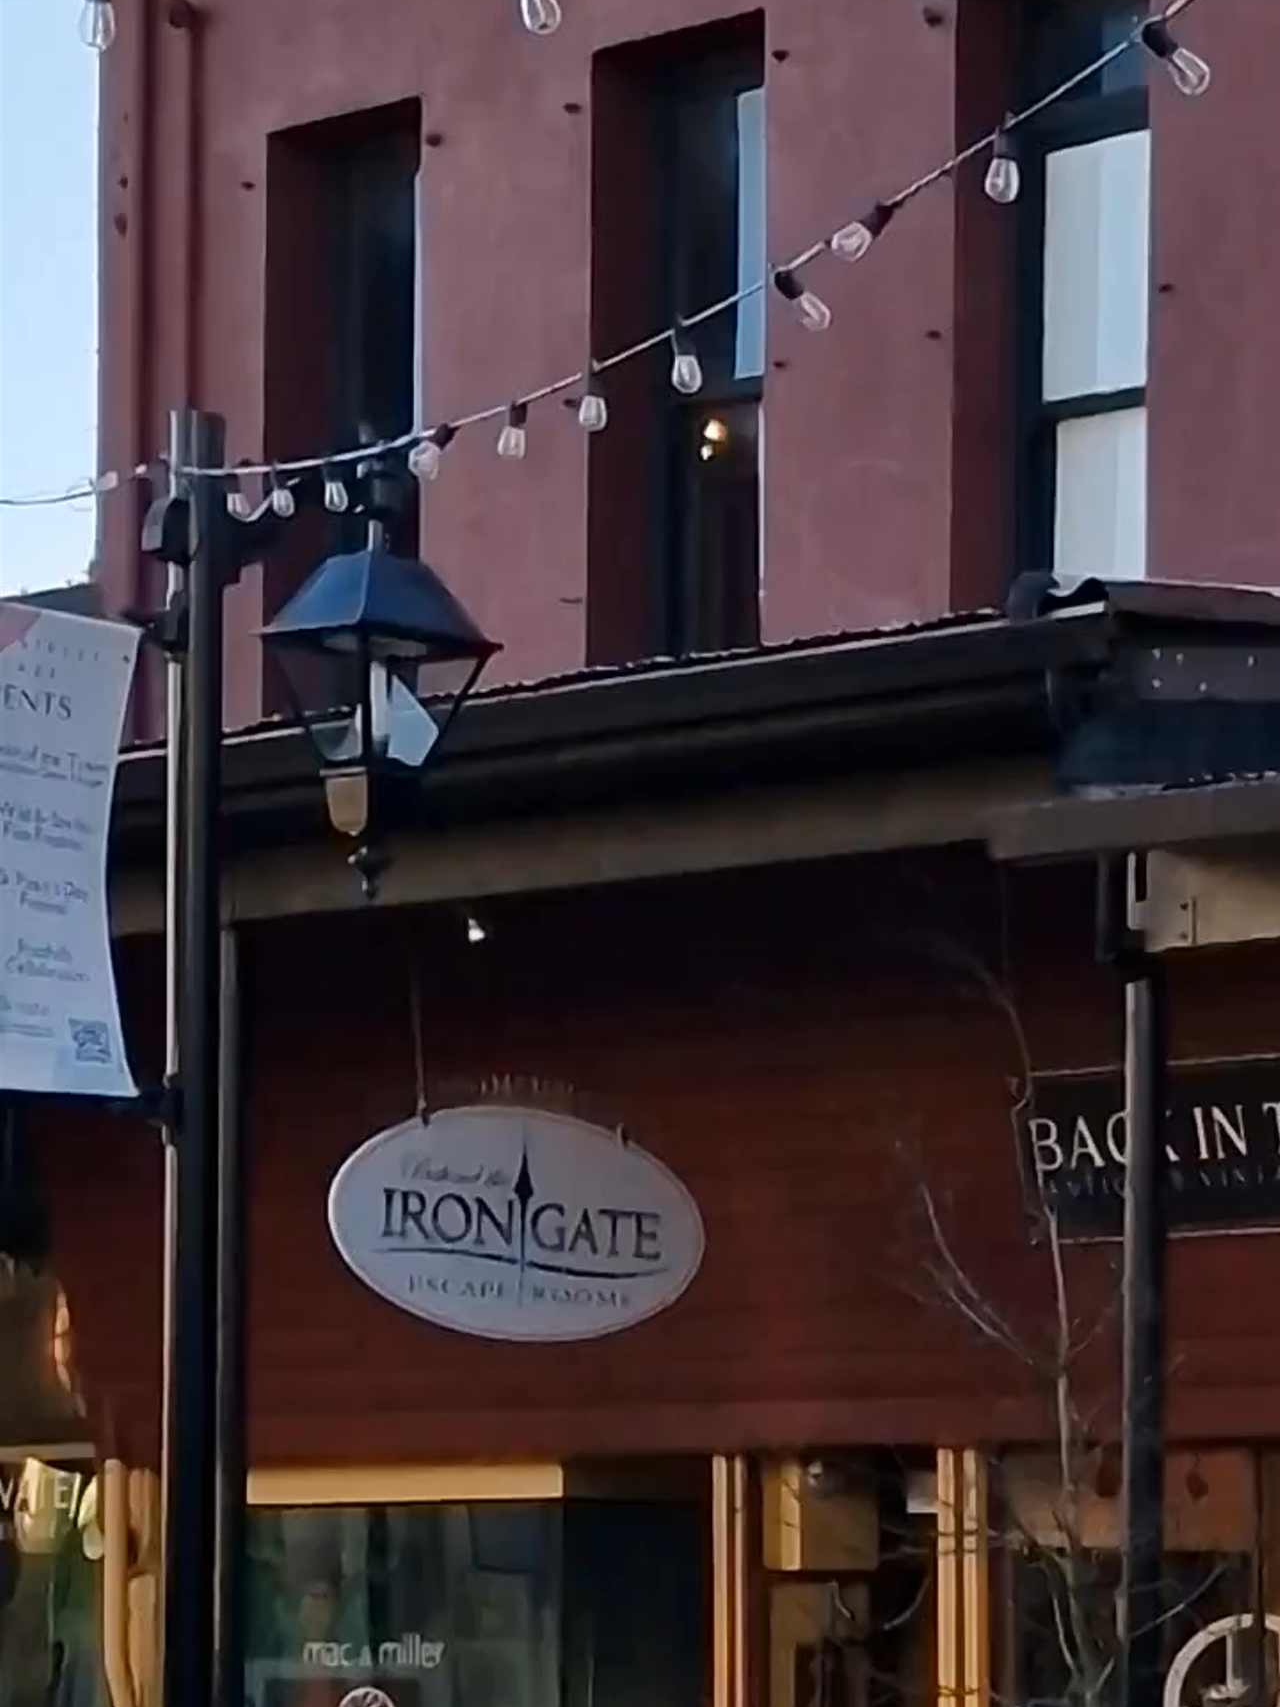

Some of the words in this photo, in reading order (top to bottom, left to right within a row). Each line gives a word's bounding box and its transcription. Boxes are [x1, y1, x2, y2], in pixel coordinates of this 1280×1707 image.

[1193, 1104, 1248, 1160] IN
[380, 1186, 516, 1247] IRON
[530, 1201, 662, 1261] GATE
[408, 1274, 504, 1299] ESCAPE
[531, 1283, 628, 1310] ROOMS
